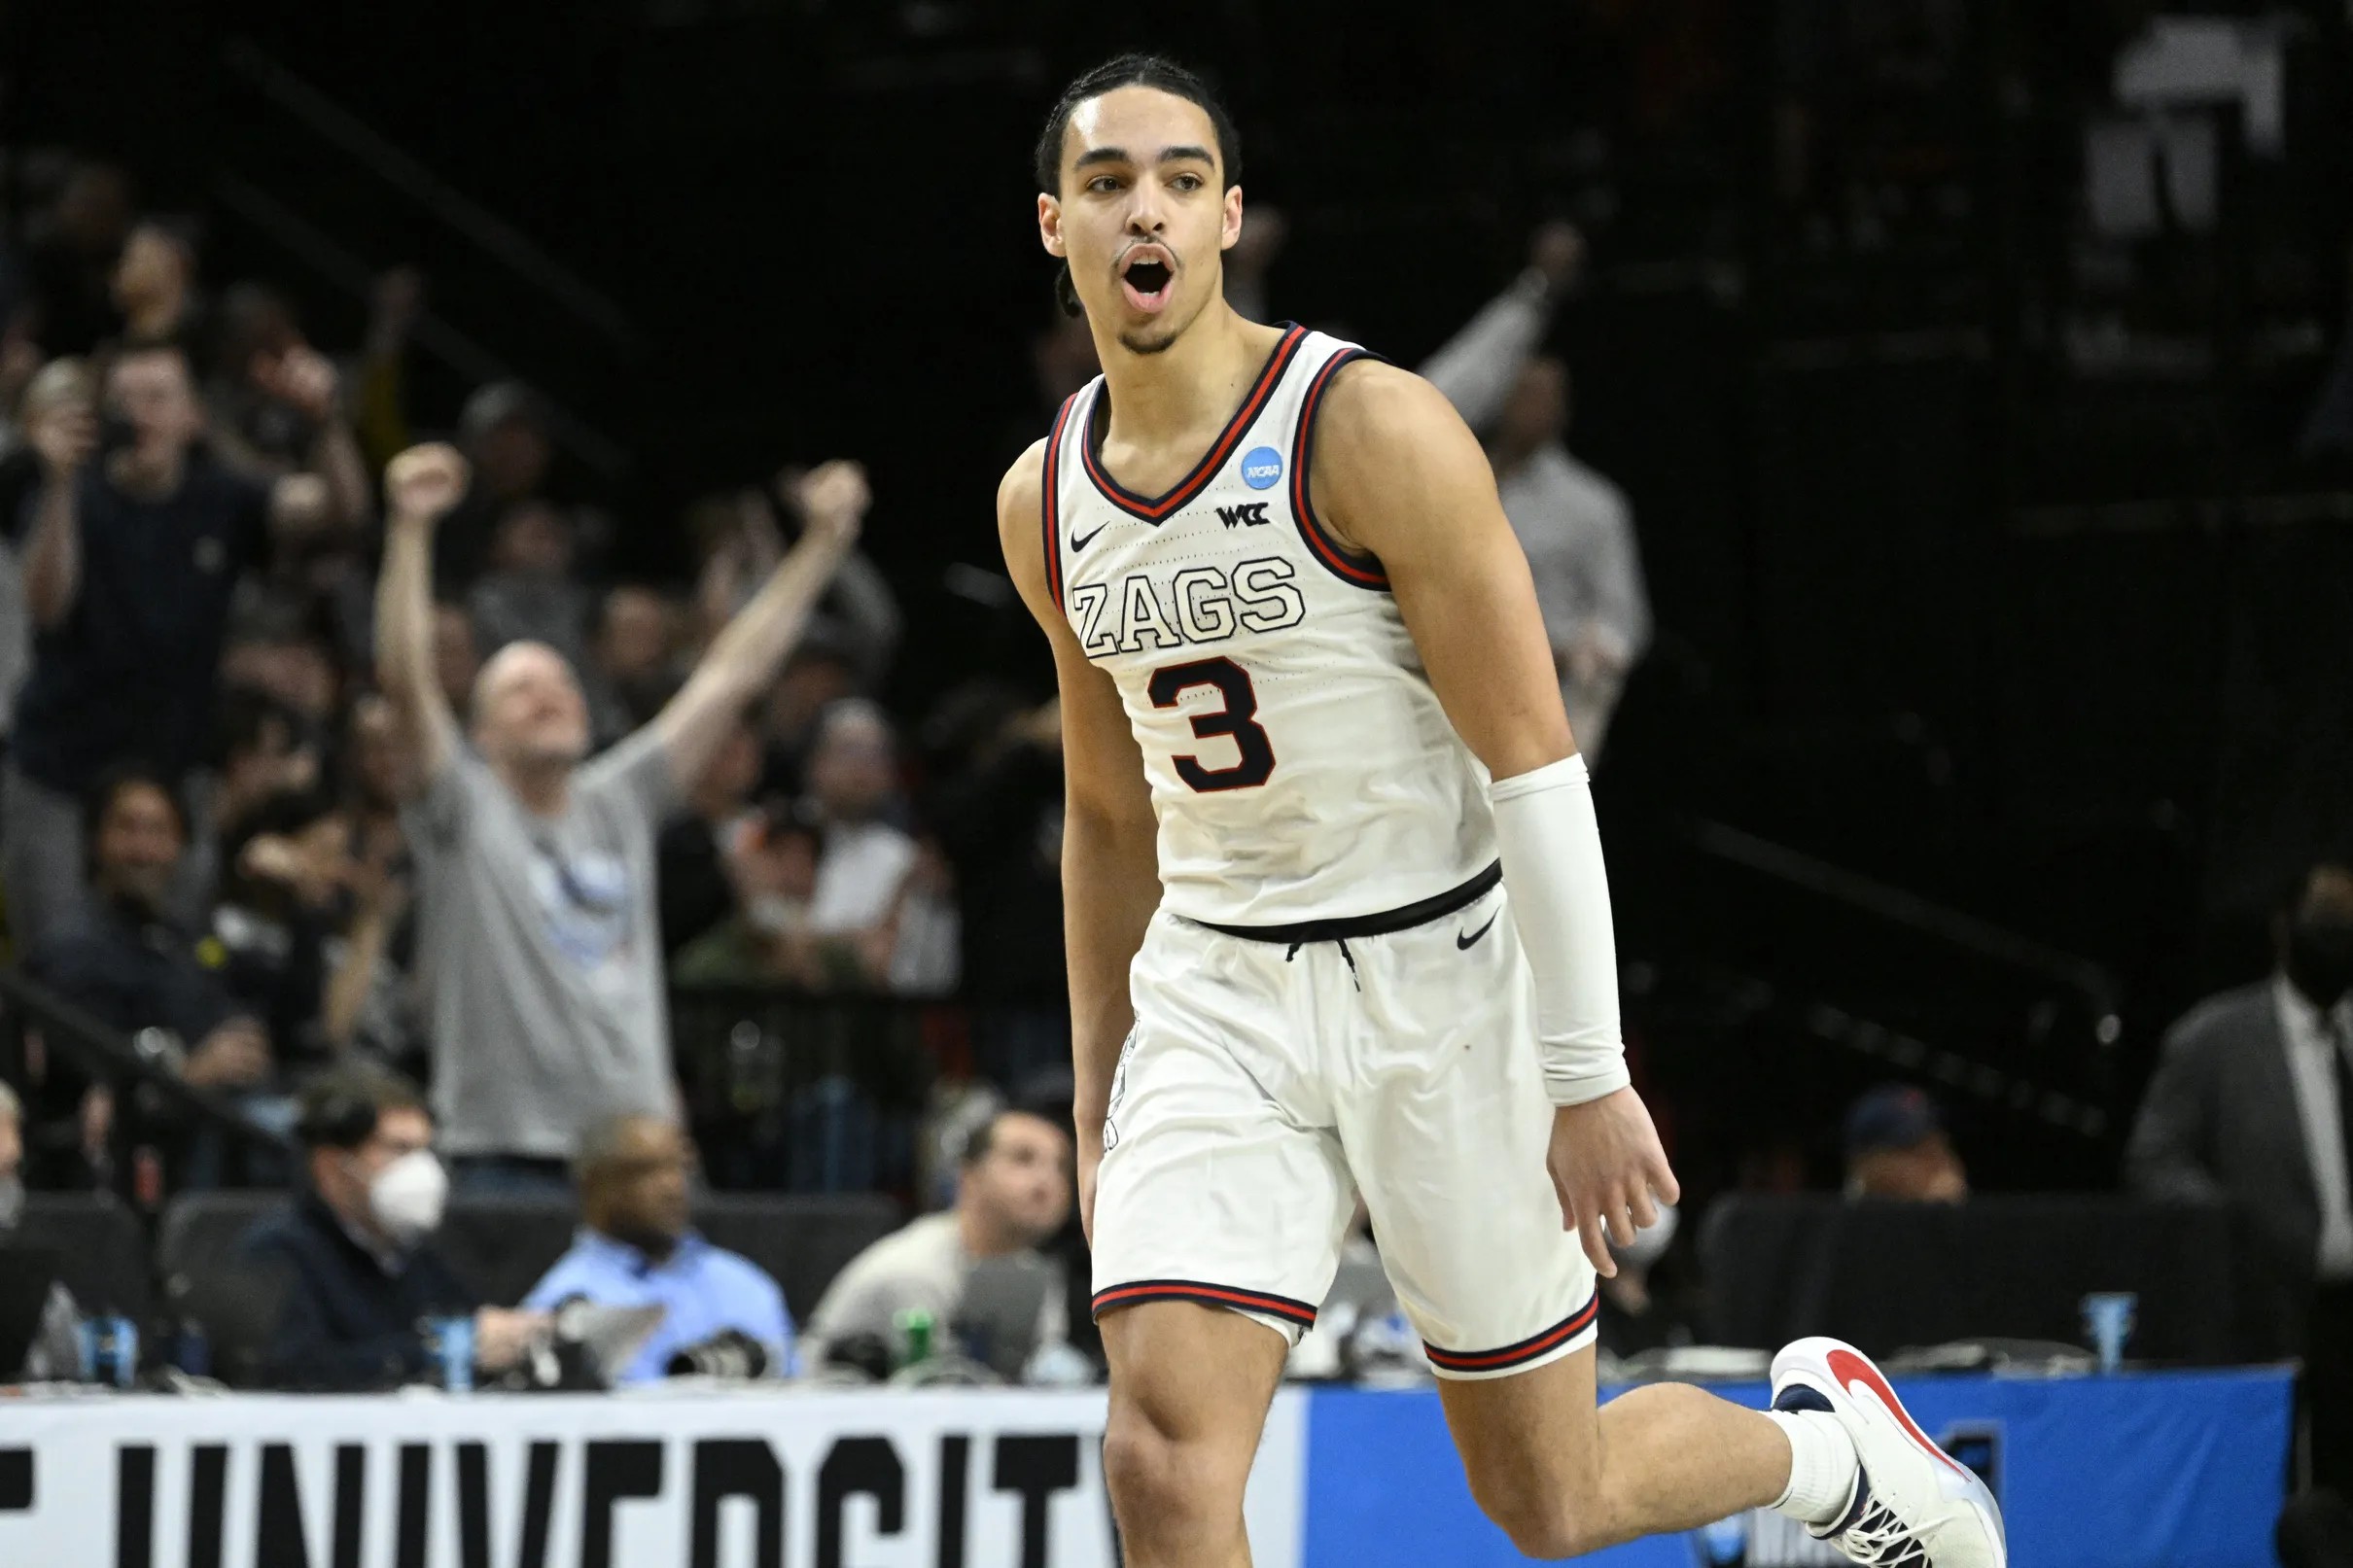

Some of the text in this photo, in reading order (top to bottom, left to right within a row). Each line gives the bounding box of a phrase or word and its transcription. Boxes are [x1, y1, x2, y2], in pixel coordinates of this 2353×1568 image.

[1247, 465, 1280, 478] NCAA
[1215, 502, 1270, 530] WCC
[1072, 556, 1306, 659] ZAGS
[1147, 655, 1276, 793] 3
